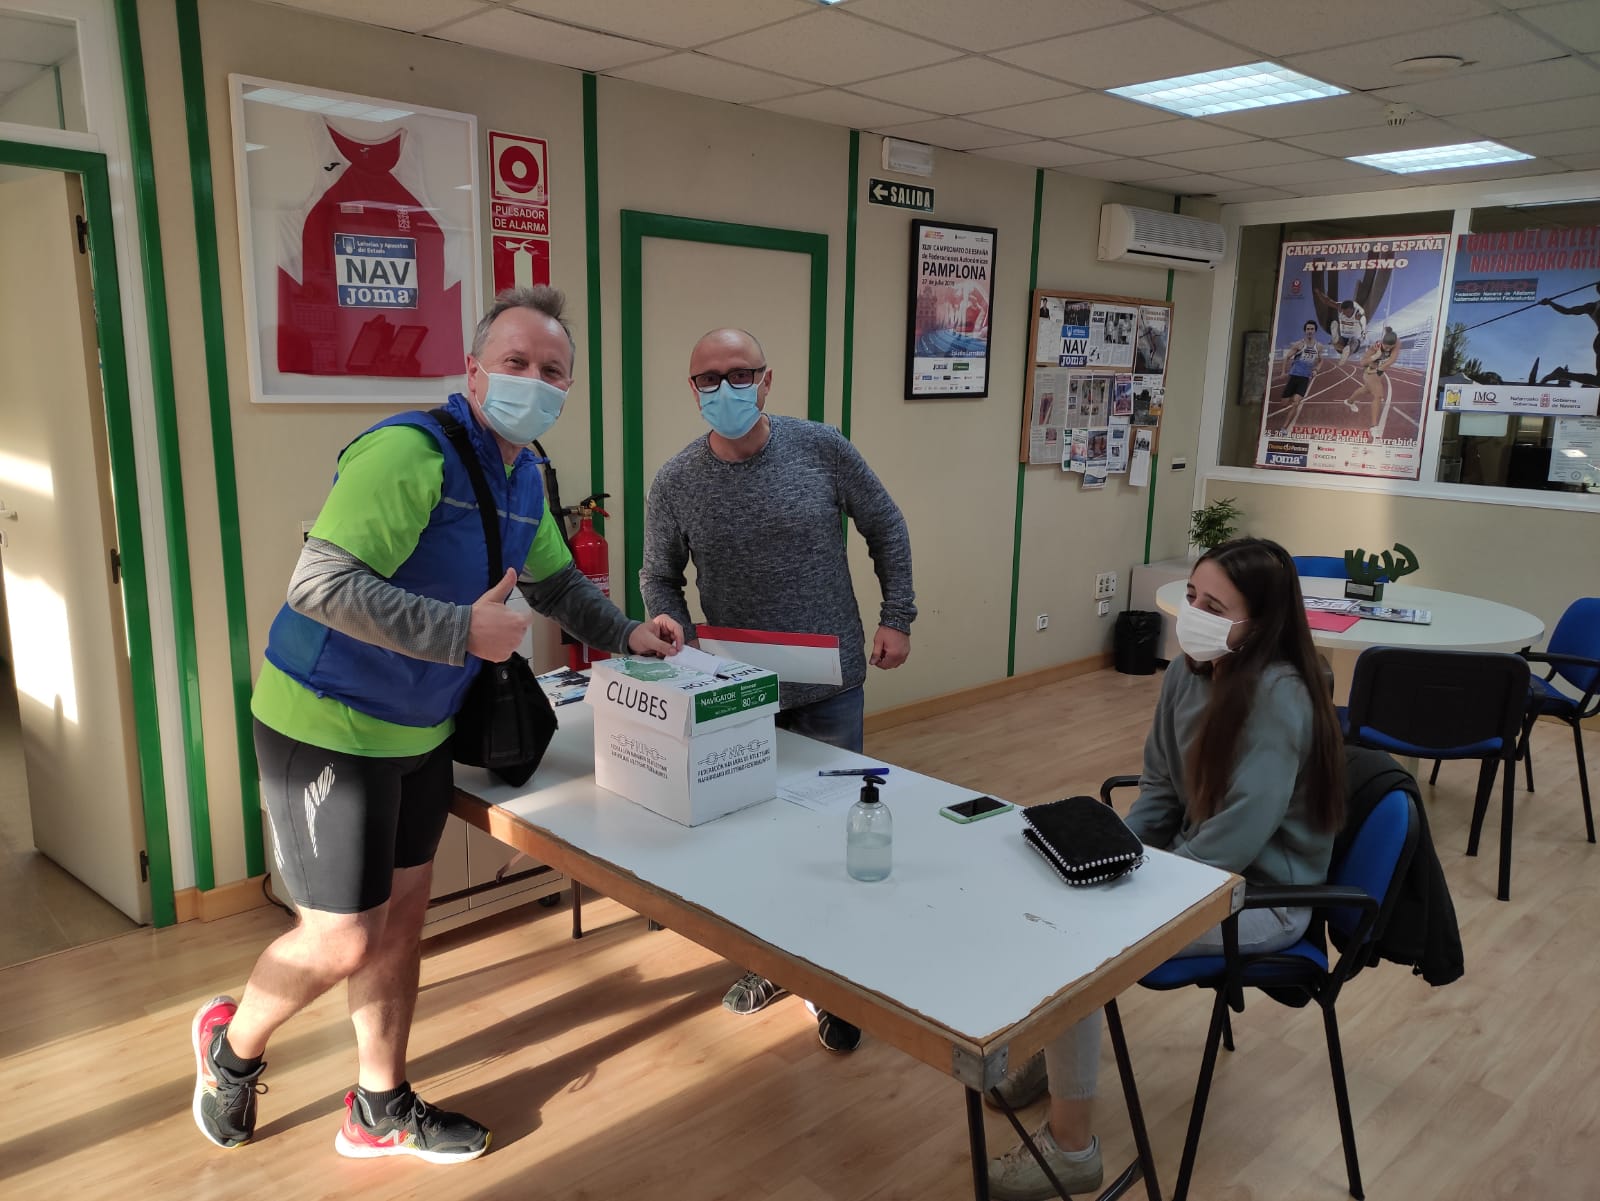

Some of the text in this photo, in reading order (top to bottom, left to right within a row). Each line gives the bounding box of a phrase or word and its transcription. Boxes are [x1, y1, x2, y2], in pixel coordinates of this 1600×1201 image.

[890, 186, 931, 208] SALIDA
[495, 205, 545, 220] PULSADOR
[494, 217, 547, 232] DE ALARMA
[1546, 225, 1600, 249] ATLET
[1286, 236, 1443, 256] CAMPEONATO de ESPAÑA
[346, 258, 410, 286] NAV
[922, 261, 986, 280] PAMPLONA
[1302, 258, 1409, 272] ATLETISMO
[1062, 338, 1088, 354] NAV
[1473, 391, 1497, 402] IMQ
[1290, 426, 1370, 438] PAMPLONA
[606, 680, 668, 721] CLUBES
[700, 692, 736, 706] NAVIGATOR
[742, 698, 751, 708] 80
